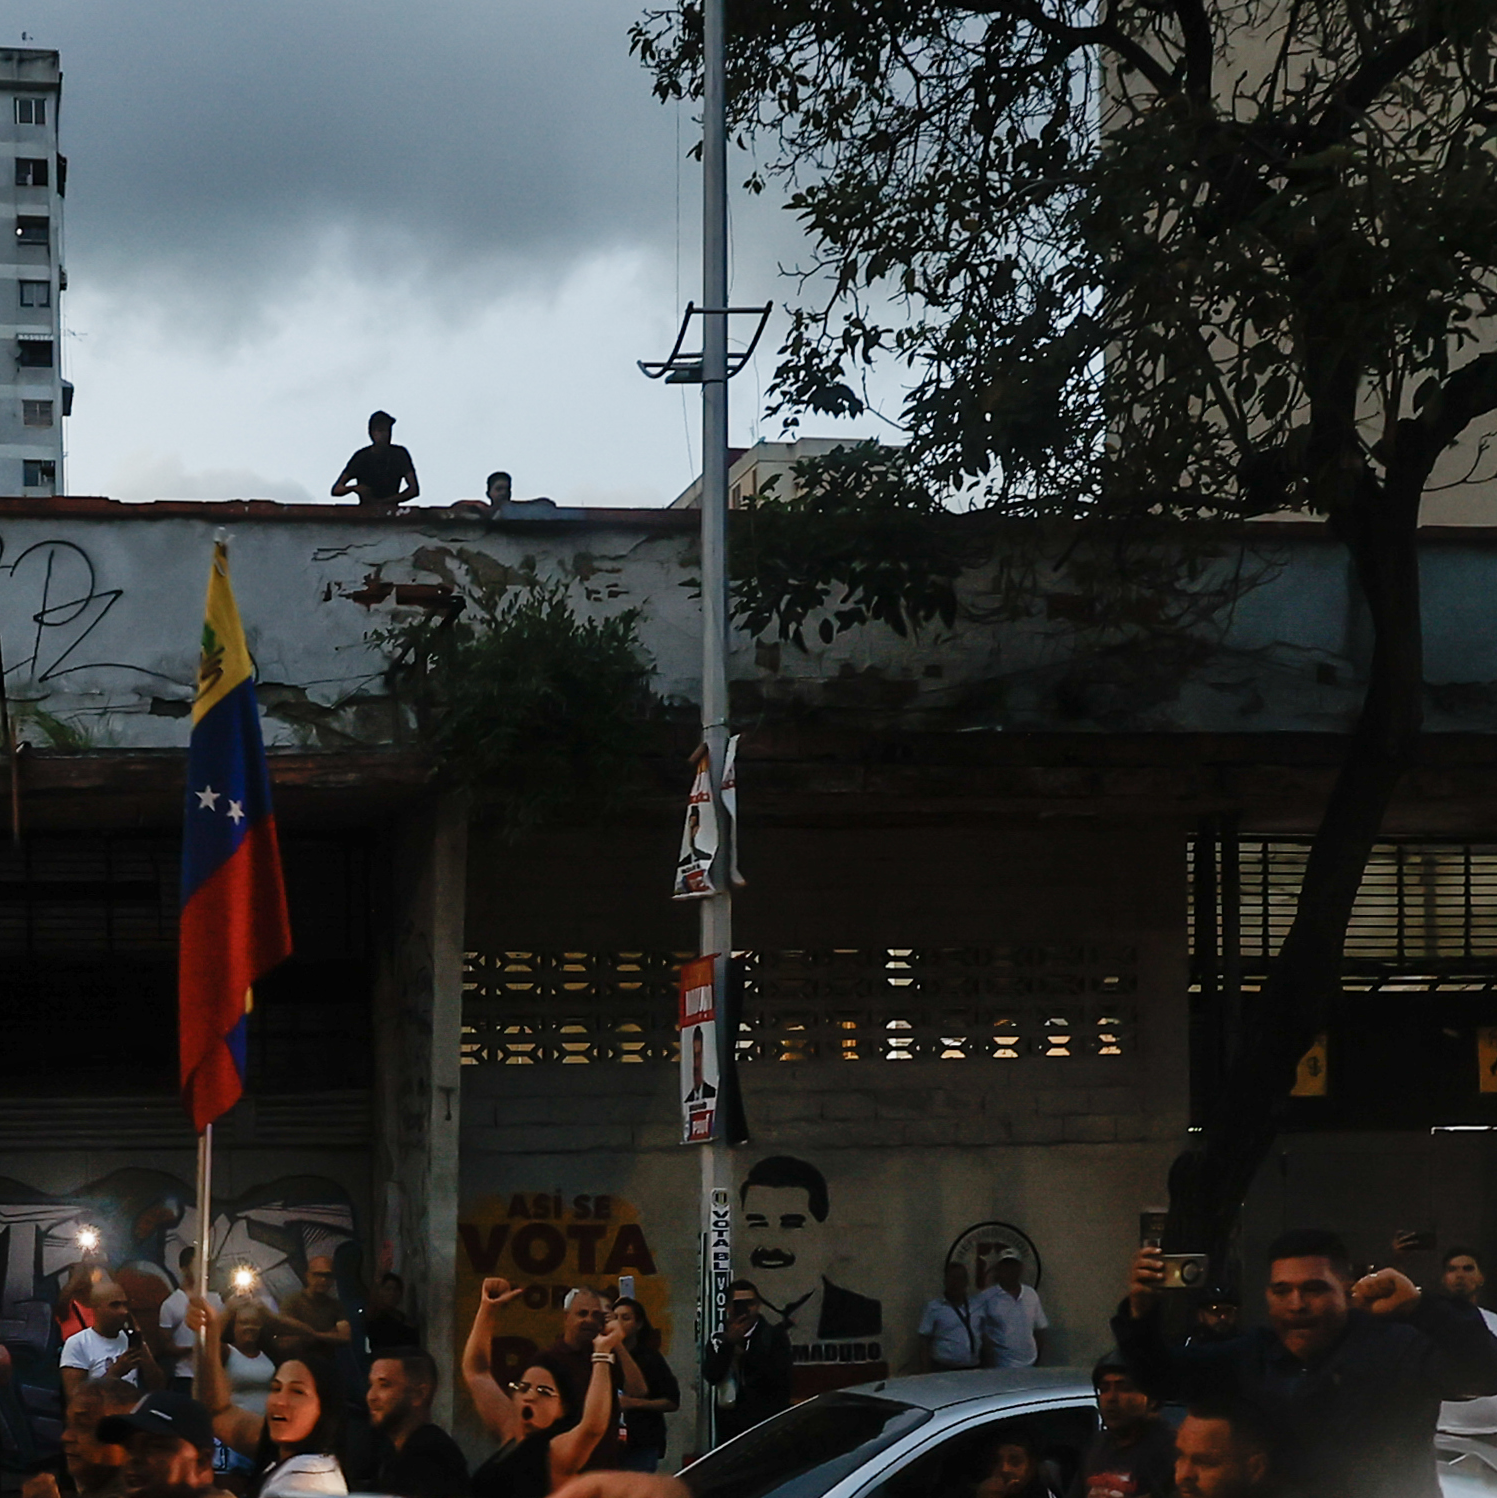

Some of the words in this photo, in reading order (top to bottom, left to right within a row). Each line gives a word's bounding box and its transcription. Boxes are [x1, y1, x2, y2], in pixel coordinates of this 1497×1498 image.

[573, 1195, 611, 1219] SE
[712, 1210, 729, 1247] VOTA
[458, 1223, 657, 1275] VOTA
[792, 1342, 881, 1362] MADURO
